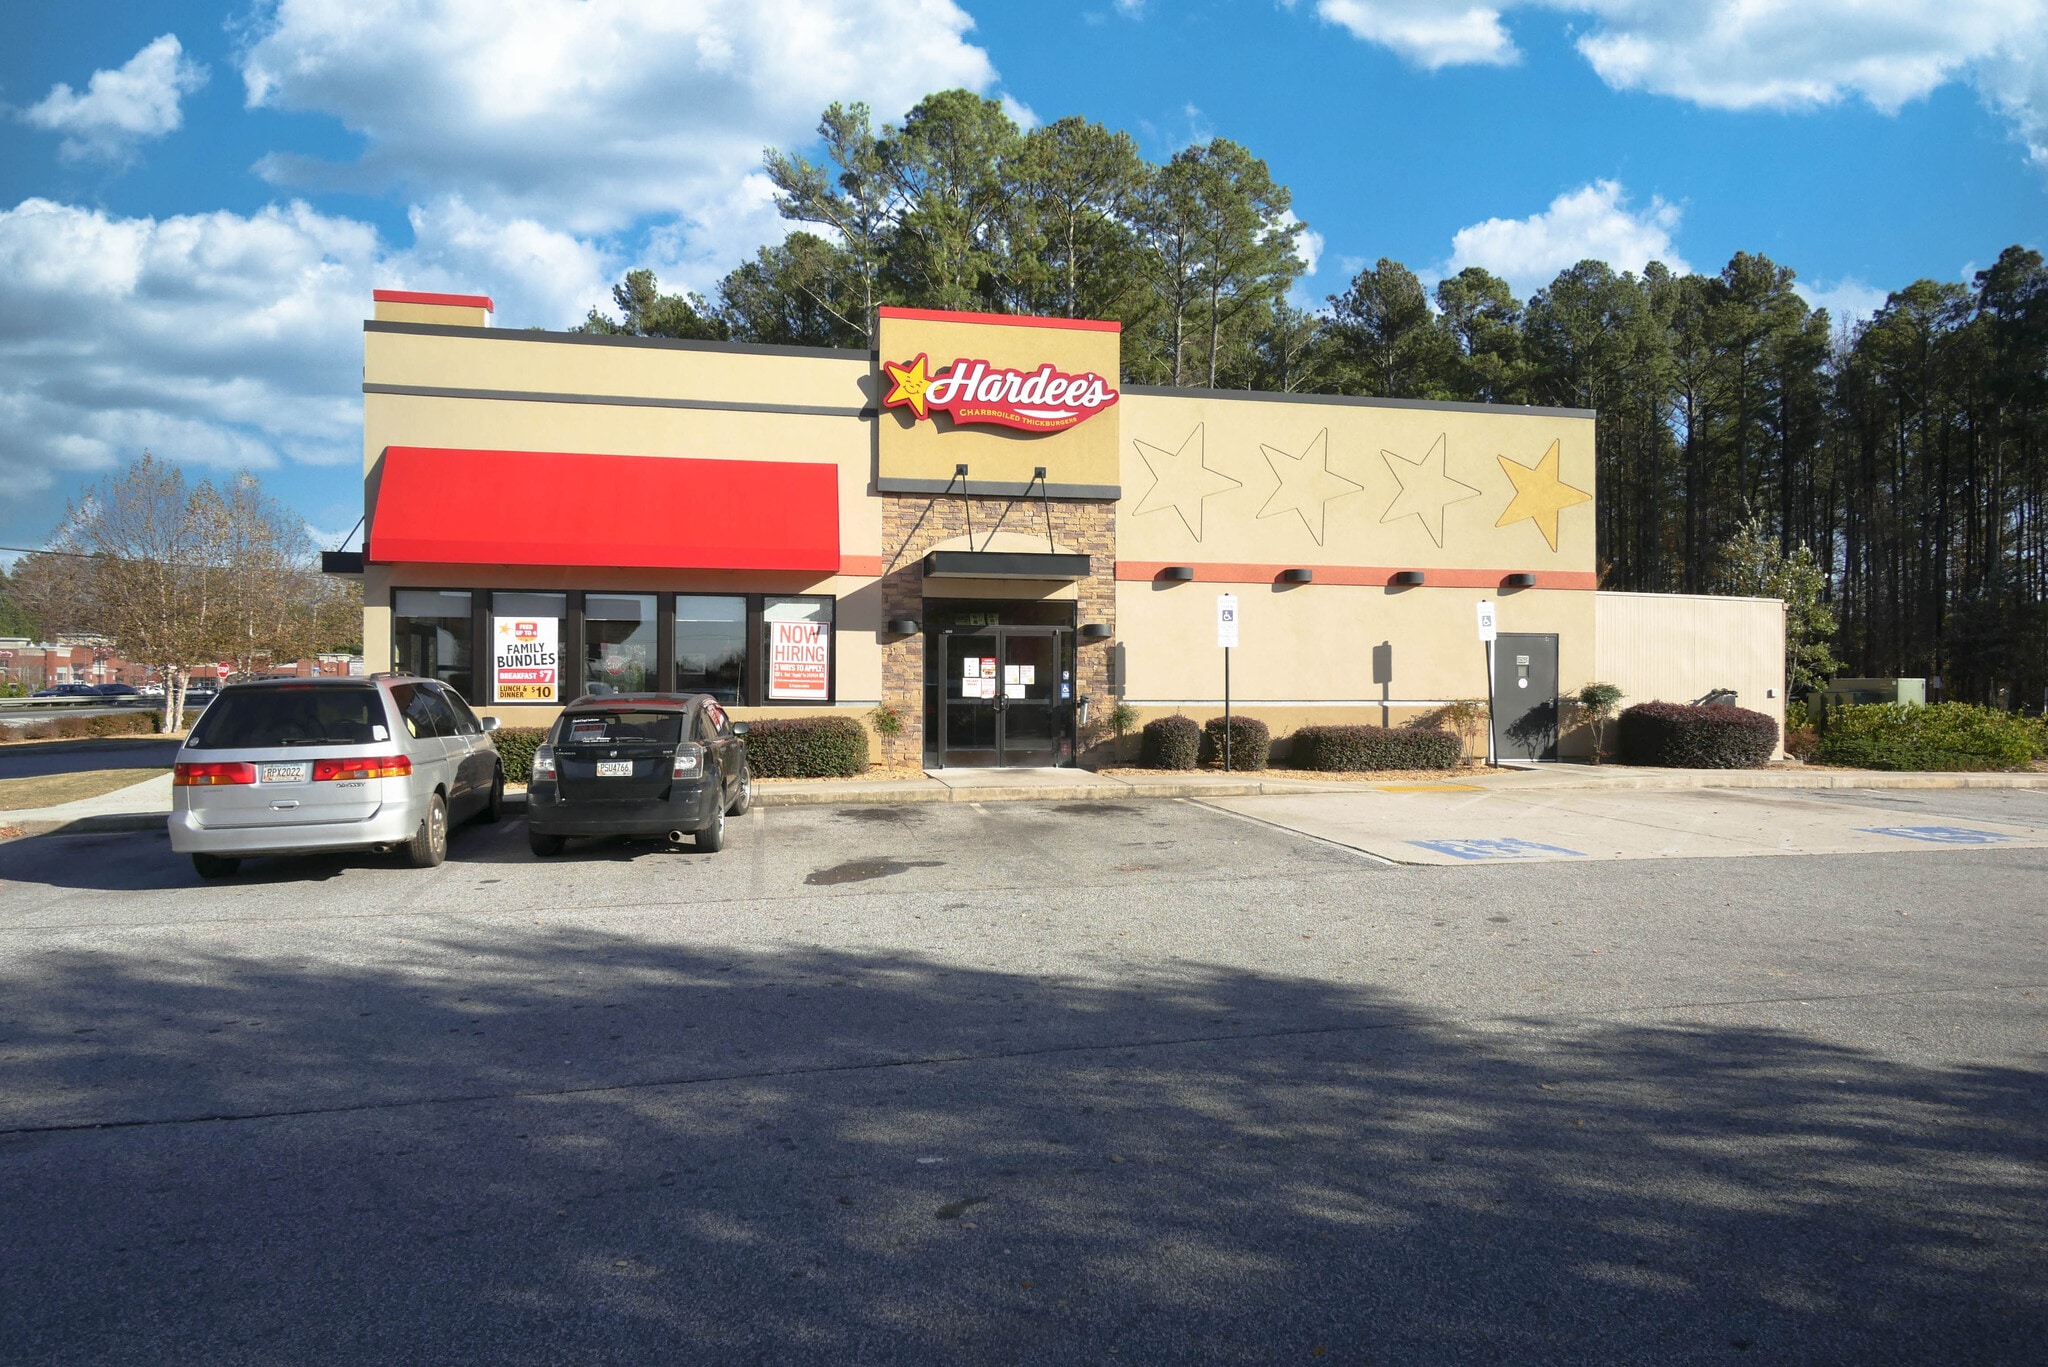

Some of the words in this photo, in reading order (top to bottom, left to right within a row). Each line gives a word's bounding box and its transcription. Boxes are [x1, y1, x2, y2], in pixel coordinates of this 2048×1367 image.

[925, 362, 1116, 407] Hardee's
[959, 408, 1020, 422] CHARBROILED
[1022, 417, 1078, 427] THICKBURGERS
[780, 625, 821, 644] NOW
[507, 643, 545, 654] FAMILY
[775, 645, 825, 662] HIRING
[497, 653, 556, 668] BUNDLES
[499, 672, 538, 680] BREAKFAST
[531, 686, 551, 698] $10
[267, 767, 301, 777] RPX2022
[600, 763, 629, 773] PSU4766
